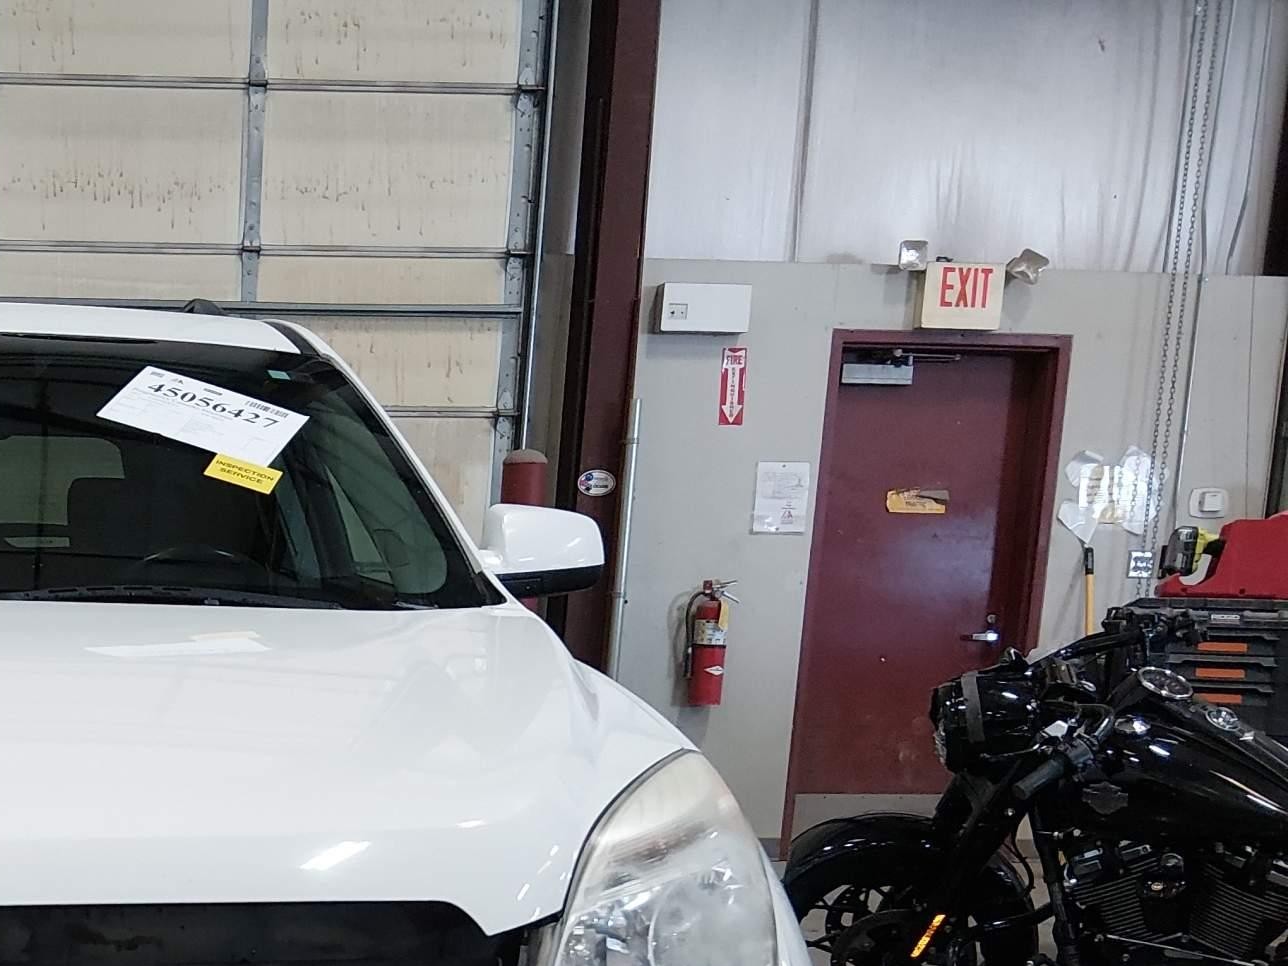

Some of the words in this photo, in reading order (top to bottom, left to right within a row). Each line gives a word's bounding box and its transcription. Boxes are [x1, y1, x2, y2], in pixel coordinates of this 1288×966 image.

[939, 266, 994, 309] EXIT
[725, 354, 743, 366] FIRE
[147, 383, 280, 429] 45056427
[215, 459, 275, 482] INSPECTION
[219, 467, 264, 485] SERVICE
